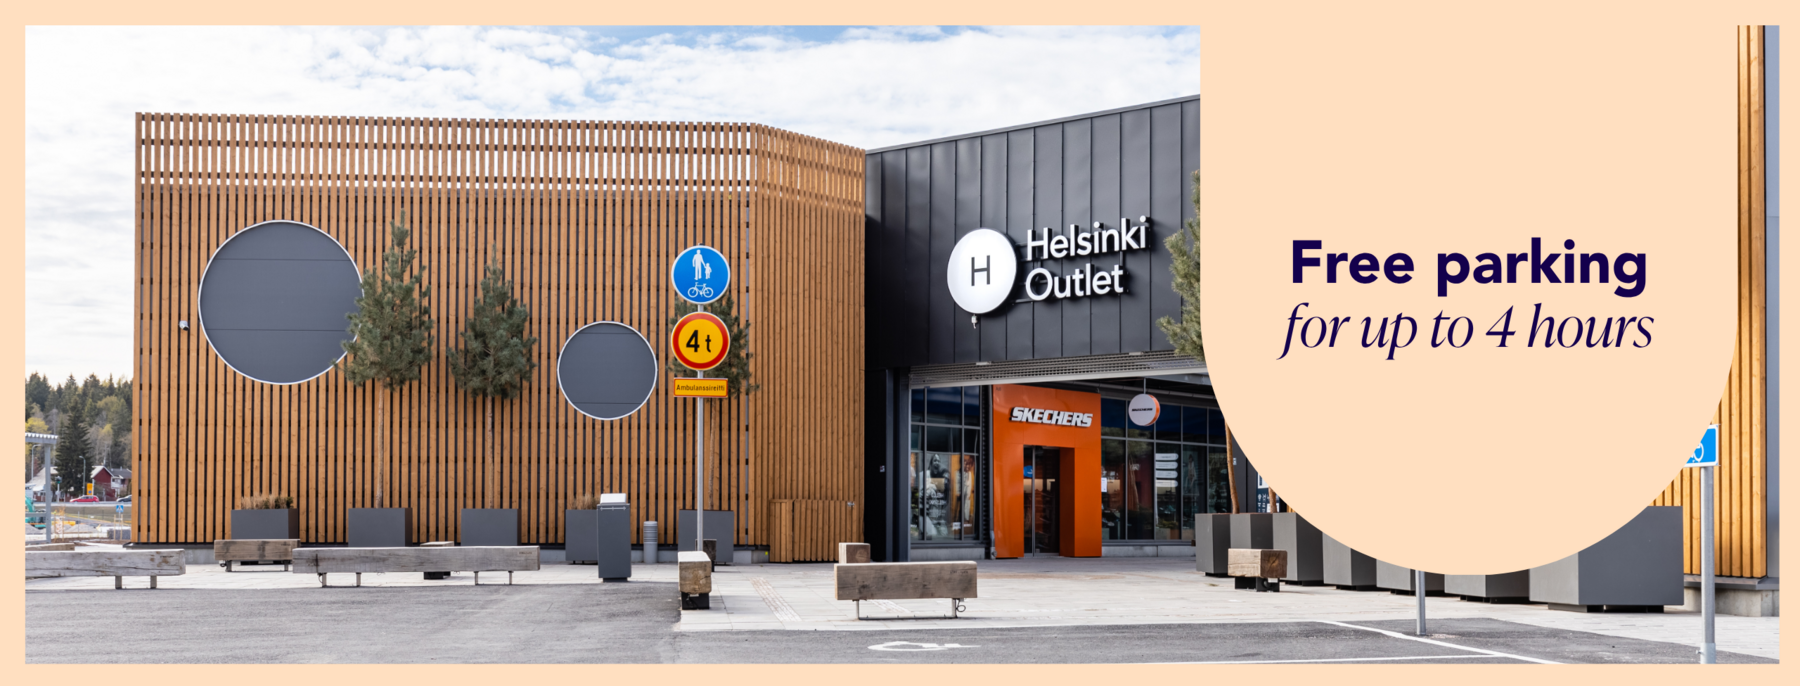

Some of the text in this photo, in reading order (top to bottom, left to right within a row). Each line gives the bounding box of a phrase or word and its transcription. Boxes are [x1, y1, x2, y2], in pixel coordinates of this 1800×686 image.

[1027, 215, 1146, 261] Helsinki
[971, 255, 991, 287] H
[1025, 263, 1124, 301] Outlet
[686, 329, 711, 352] 4 t
[676, 383, 725, 392] Ambulanssireitti
[1011, 406, 1093, 428] SKECHERS
